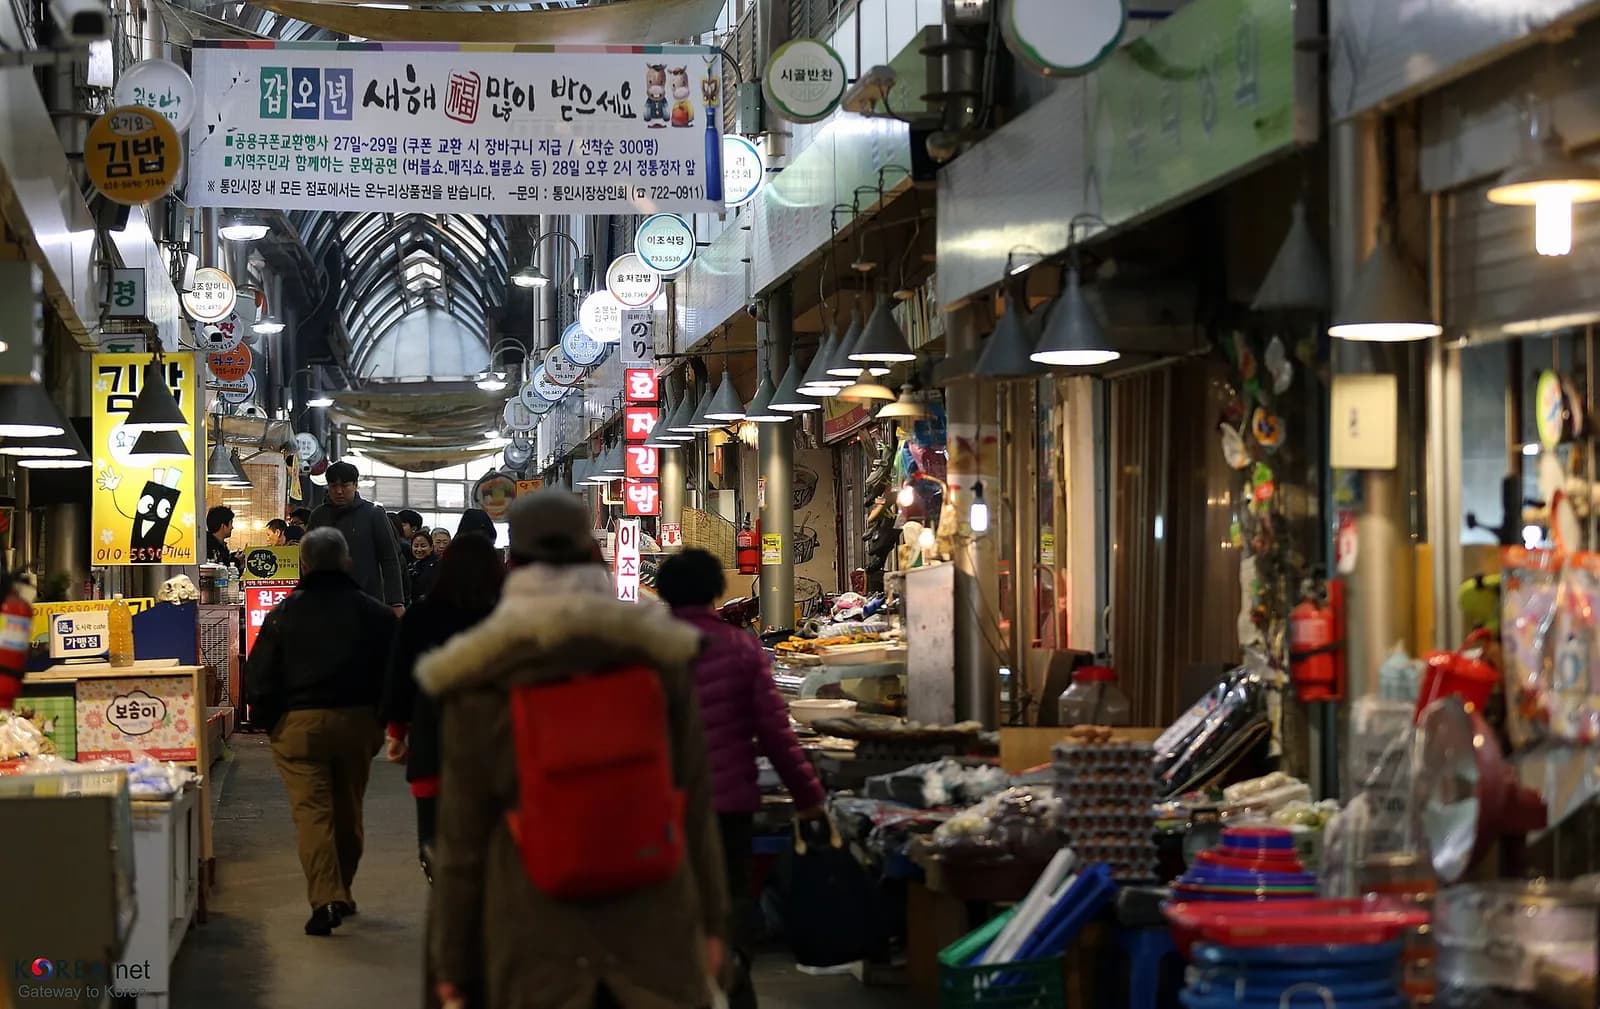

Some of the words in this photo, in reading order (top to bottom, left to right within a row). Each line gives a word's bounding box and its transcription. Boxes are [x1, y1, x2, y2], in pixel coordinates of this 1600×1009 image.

[781, 68, 833, 81] 시골반찬
[264, 73, 347, 114] 갑오년
[362, 64, 435, 115] 새해
[486, 75, 535, 122] 많이
[551, 75, 637, 121] 받으세요
[235, 133, 328, 151] 공용쿠폰교환행사
[334, 136, 397, 153] 27일~29일
[402, 137, 432, 154] (쿠폰
[437, 138, 462, 155] 교환
[467, 138, 479, 155] 시
[485, 138, 532, 155] 장바구니
[538, 139, 562, 156] 지급
[580, 139, 614, 156] 선착순
[619, 139, 659, 156] 300명)
[97, 136, 165, 178] 김밥
[233, 153, 290, 170] 지역주민과
[295, 155, 344, 172] 함께하는
[349, 156, 397, 174] 문화공연
[530, 159, 547, 176] 등)
[552, 160, 580, 177] 28일
[585, 160, 609, 177] 오후
[613, 160, 632, 177] 2시
[637, 160, 681, 177] 정통정자
[685, 160, 696, 177] 앞
[219, 179, 262, 195] 통인시장
[265, 180, 276, 196] 내
[279, 181, 302, 196] 모든
[306, 181, 361, 198] 점포에서는
[365, 183, 443, 200] 온누리상품권을
[447, 184, 495, 201] 받습니다.
[552, 185, 628, 201] 통인시장상인회
[651, 185, 704, 200] 722-0911)
[647, 236, 685, 246] 이조식당
[617, 274, 651, 283] 효자김밥
[631, 322, 648, 358] のり
[628, 372, 658, 513] 효자김밥
[66, 636, 98, 649] 가맹점
[116, 700, 156, 719] 보솜이
